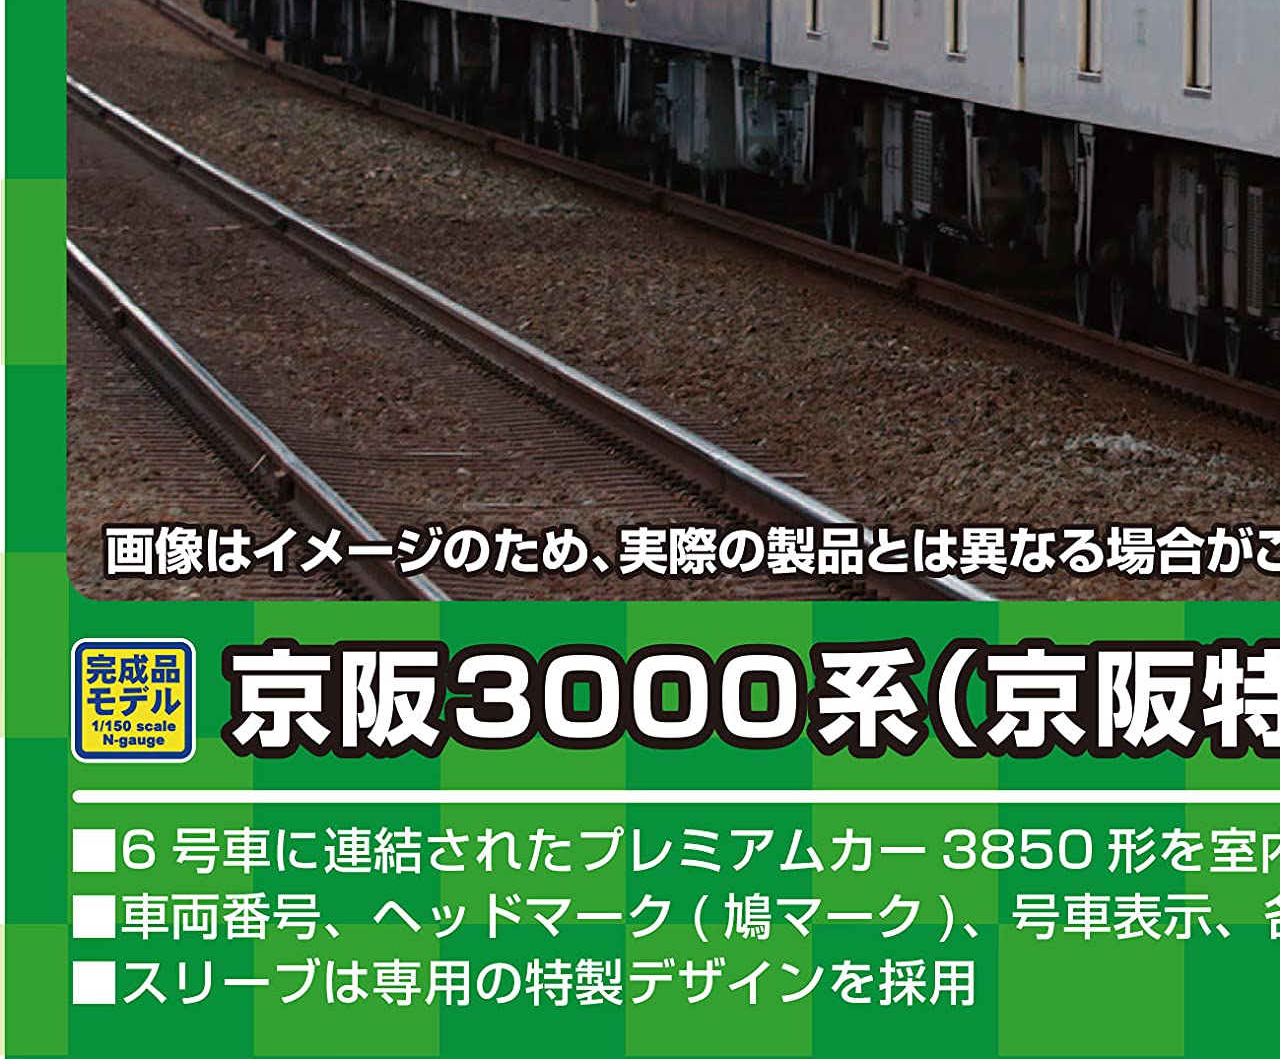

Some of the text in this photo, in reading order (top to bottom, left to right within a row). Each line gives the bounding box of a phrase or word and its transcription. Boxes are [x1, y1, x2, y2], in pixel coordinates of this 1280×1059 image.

[86, 654, 181, 684] 完成品
[86, 686, 182, 716] モデル
[91, 720, 177, 732] 1/150 scale
[103, 734, 165, 748] N-gauge
